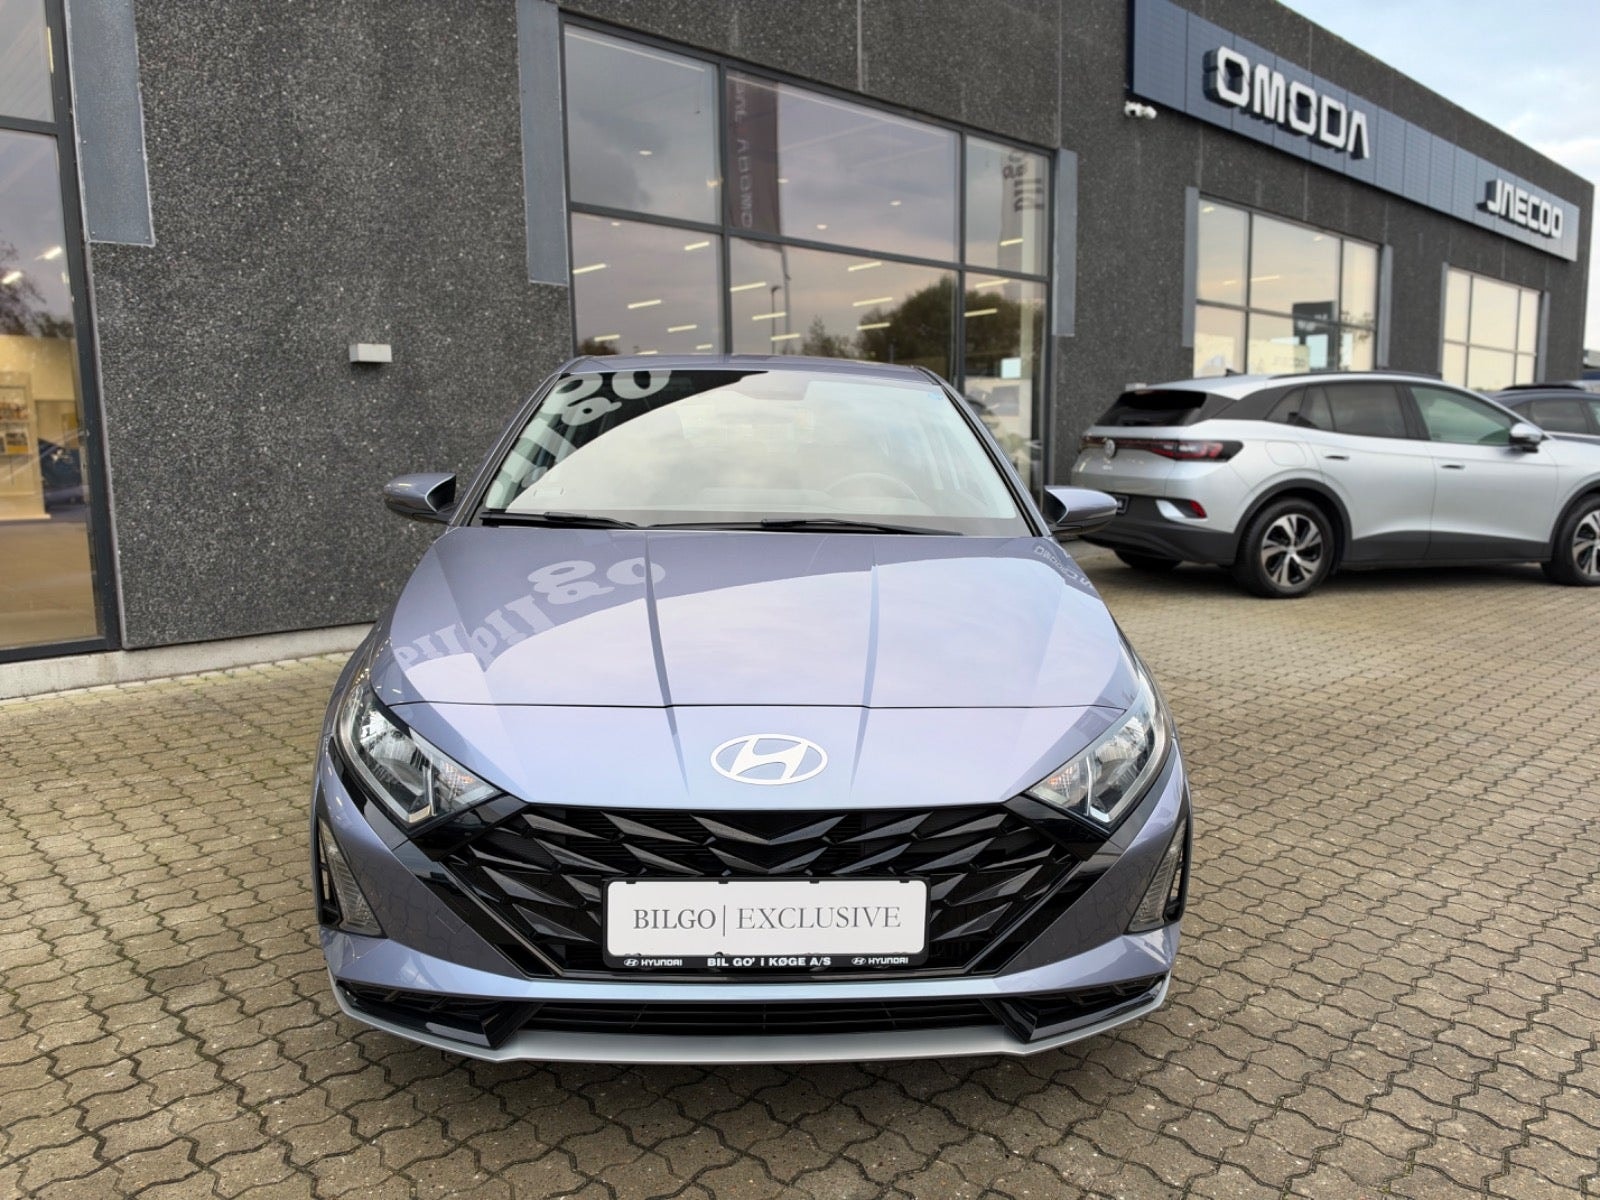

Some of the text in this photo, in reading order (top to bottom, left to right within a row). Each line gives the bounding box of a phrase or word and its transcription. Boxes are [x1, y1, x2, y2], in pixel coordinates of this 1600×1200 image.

[1214, 45, 1370, 160] OMODA
[1486, 178, 1564, 240] JAECOO
[633, 906, 901, 930] BILGO EXCLUSIVE
[641, 958, 683, 967] HYUNDAI
[707, 957, 729, 967] BIL
[768, 957, 806, 967] KØGE
[809, 957, 832, 967] A/S
[868, 957, 909, 965] HYUNDAI
